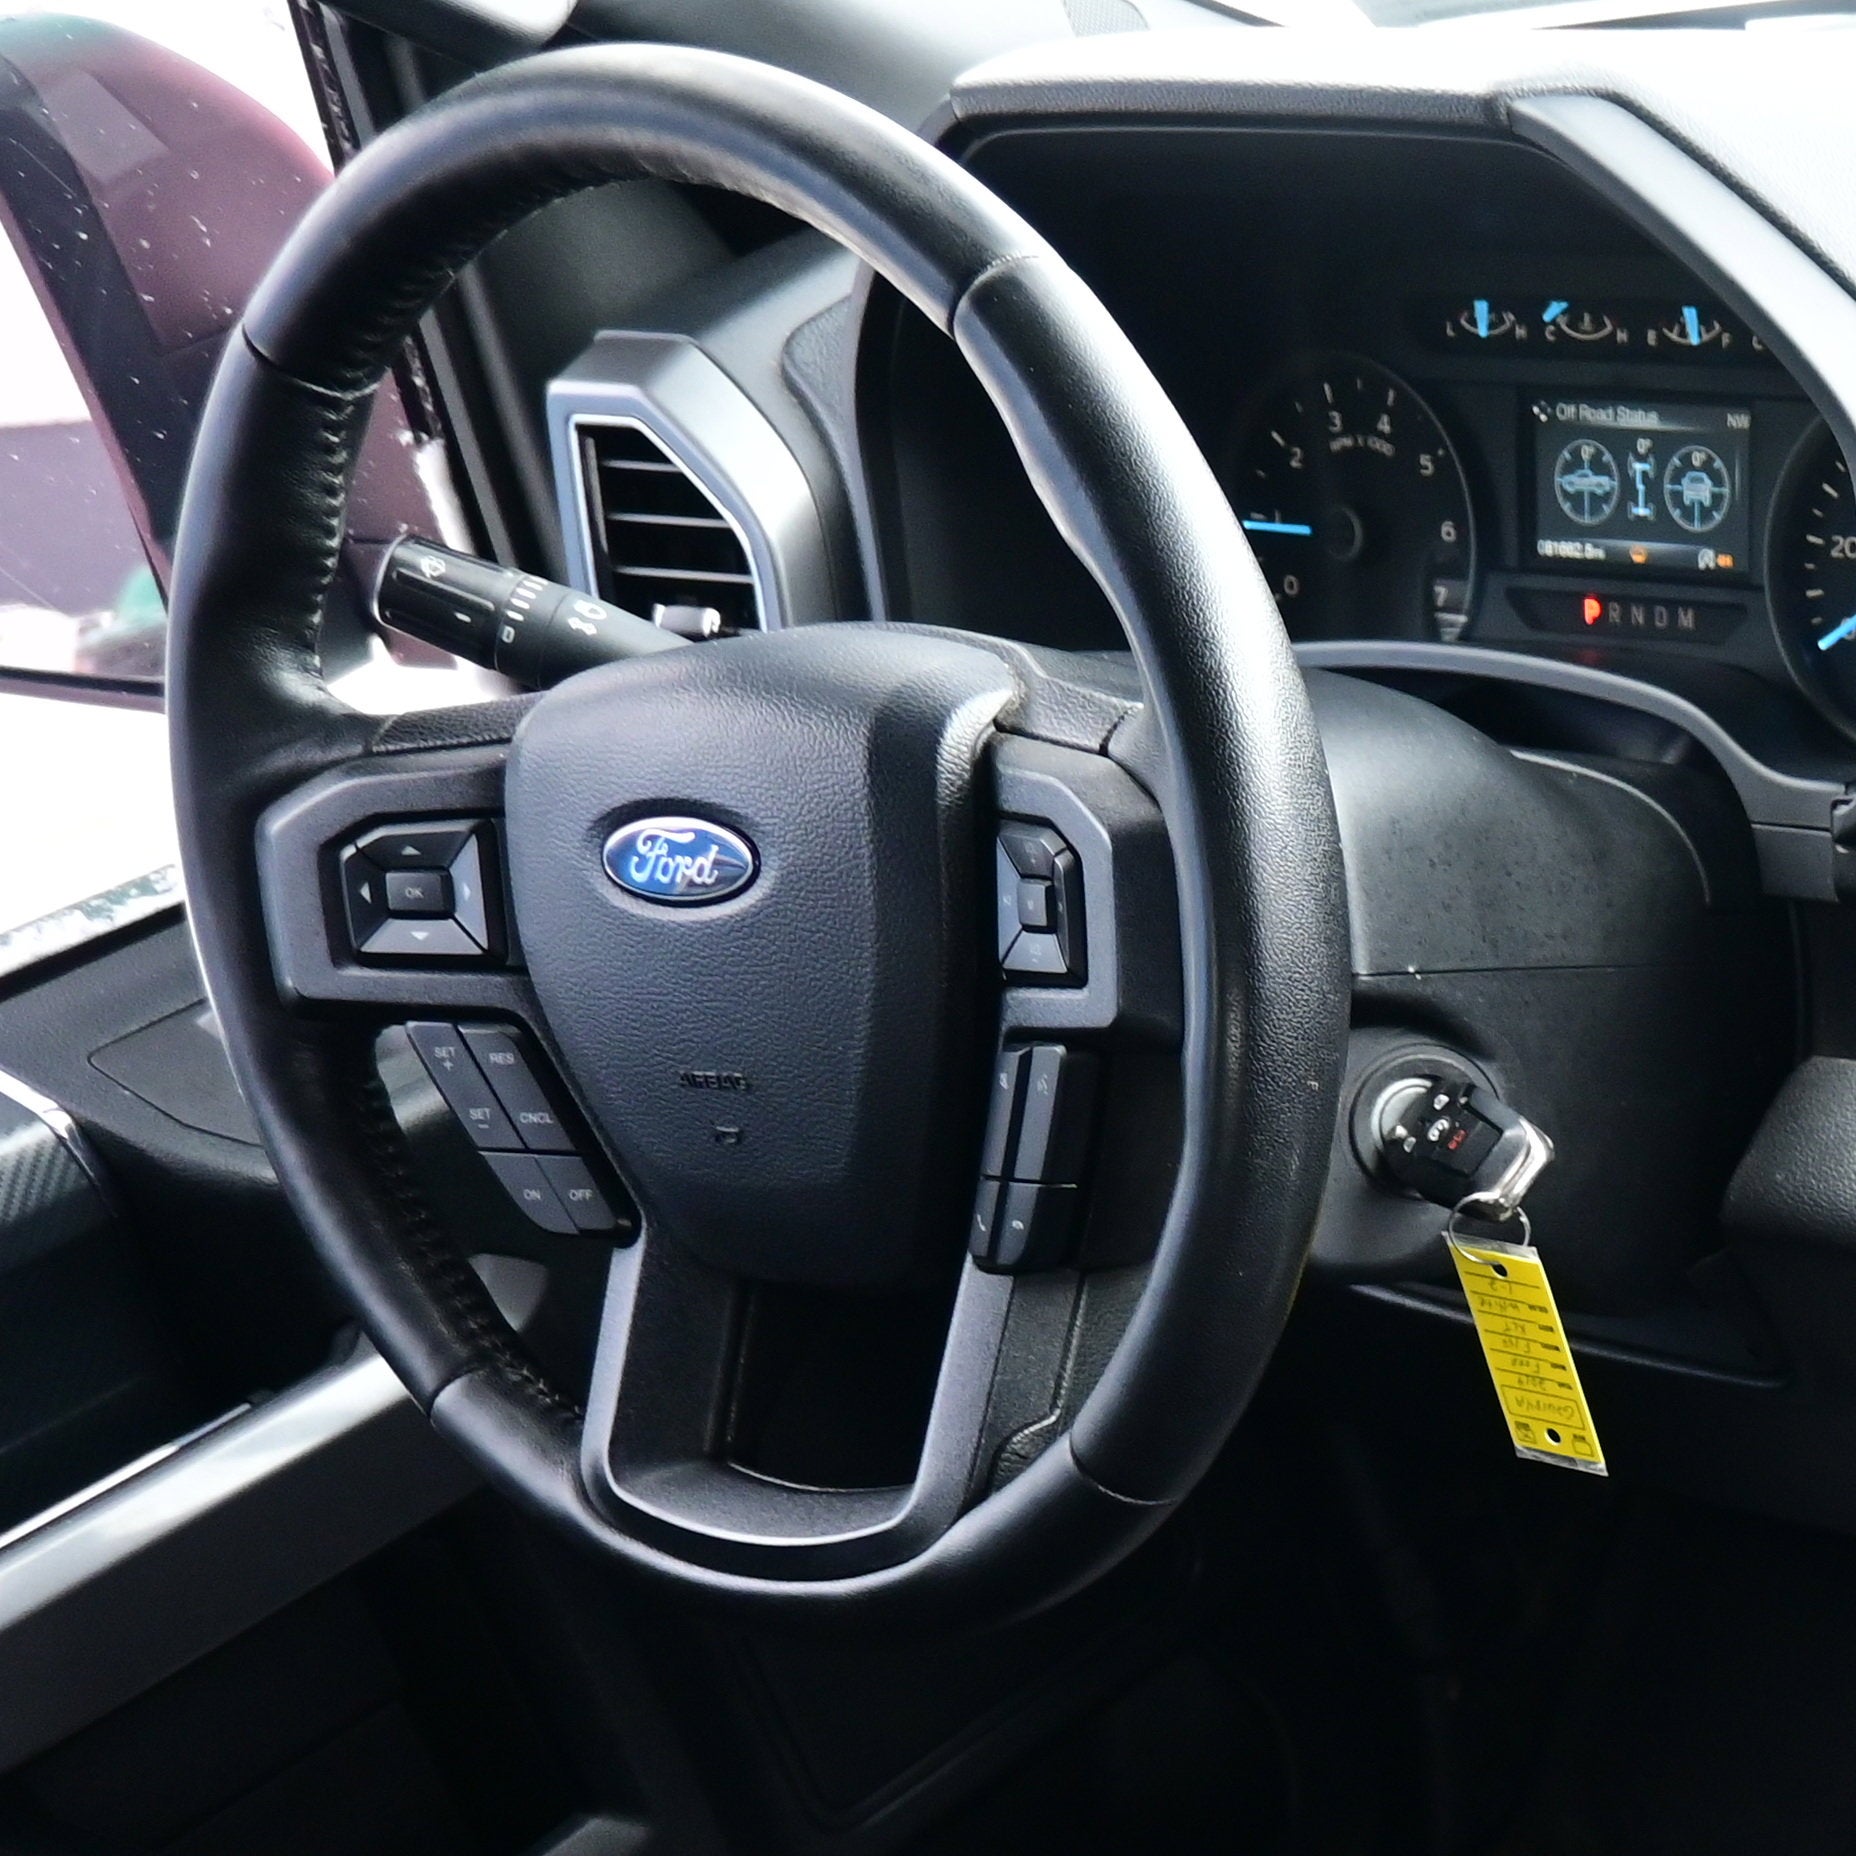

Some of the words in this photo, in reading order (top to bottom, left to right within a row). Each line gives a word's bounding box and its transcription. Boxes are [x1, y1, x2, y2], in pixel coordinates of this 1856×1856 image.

[1328, 410, 1343, 432] 3
[1556, 403, 1577, 421] Off
[1579, 404, 1614, 422] Road
[1616, 406, 1659, 423] Status
[1377, 414, 1392, 434] 4
[1290, 447, 1303, 469] 2
[1420, 454, 1434, 476] 5
[1440, 520, 1456, 542] 6
[1283, 575, 1298, 595] 0
[1434, 585, 1448, 607] 7
[1608, 602, 1621, 623] R
[1631, 606, 1645, 626] N
[1654, 607, 1668, 628] D
[1677, 608, 1696, 630] M
[630, 828, 719, 885] Ford
[434, 1046, 455, 1058] SET
[489, 1052, 514, 1065] RES
[679, 1071, 751, 1091] AIRBAG
[469, 1108, 491, 1121] SET
[520, 1111, 553, 1124] CNCL
[523, 1189, 541, 1200] ON
[569, 1189, 593, 1201] OFF
